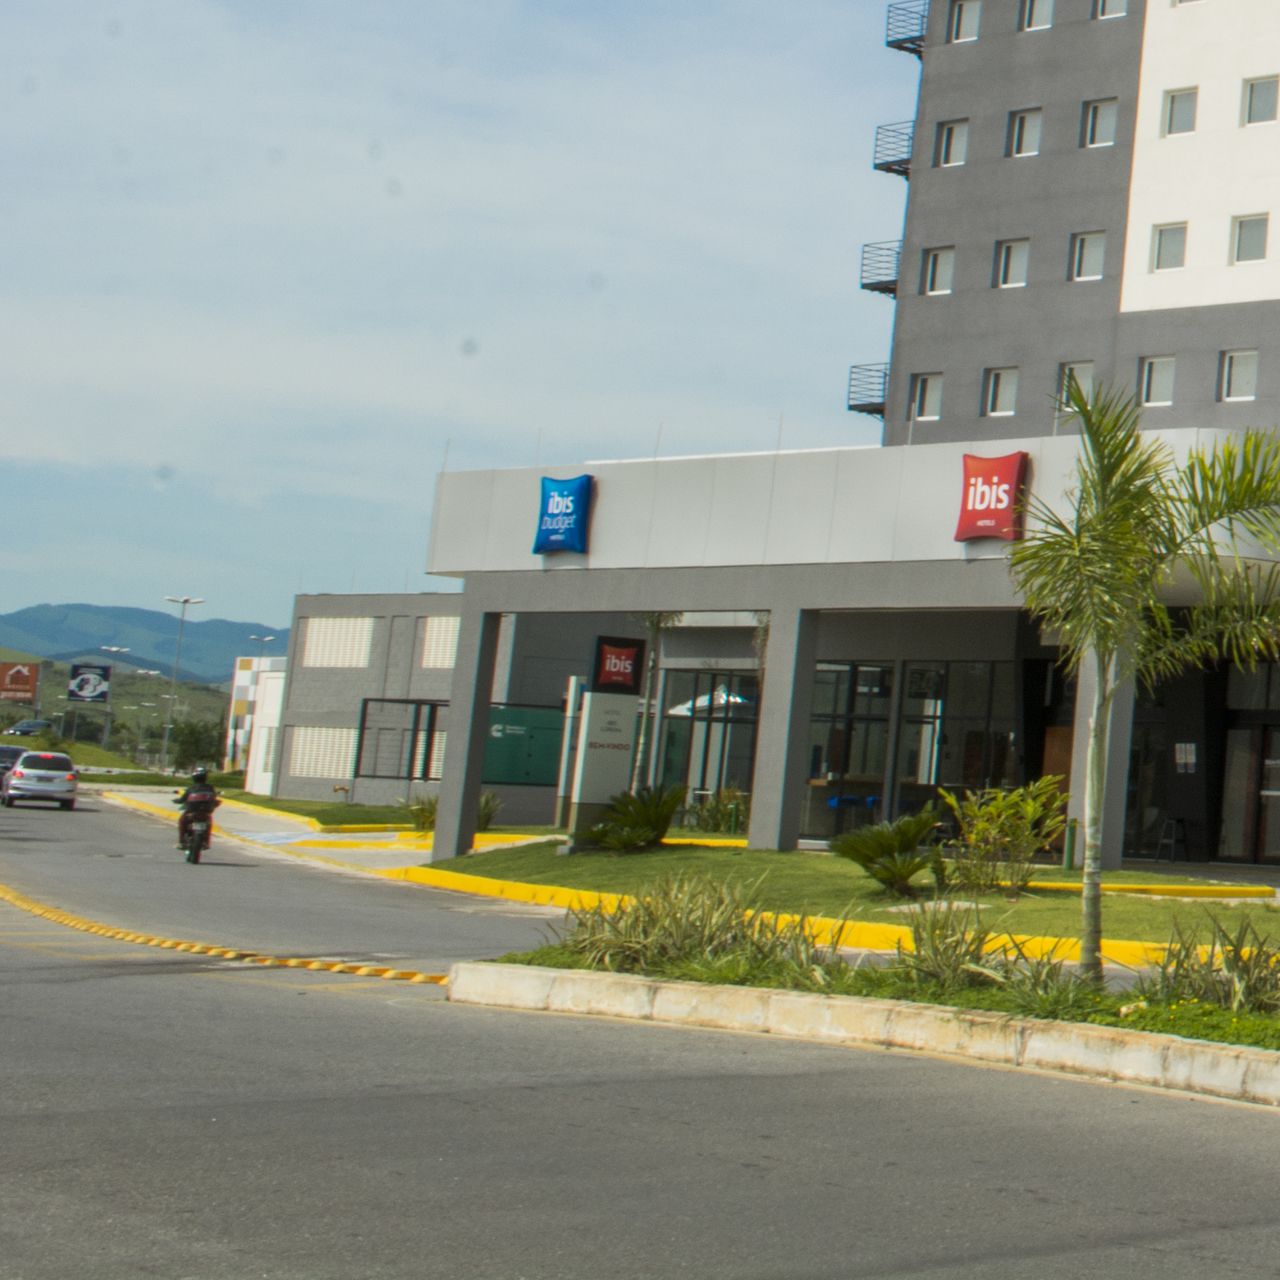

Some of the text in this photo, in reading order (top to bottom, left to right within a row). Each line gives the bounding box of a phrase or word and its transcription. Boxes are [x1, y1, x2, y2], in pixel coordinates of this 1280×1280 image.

[548, 491, 574, 514] ibis
[967, 476, 1010, 510] ibis
[541, 514, 576, 533] budget
[605, 654, 633, 672] ibis
